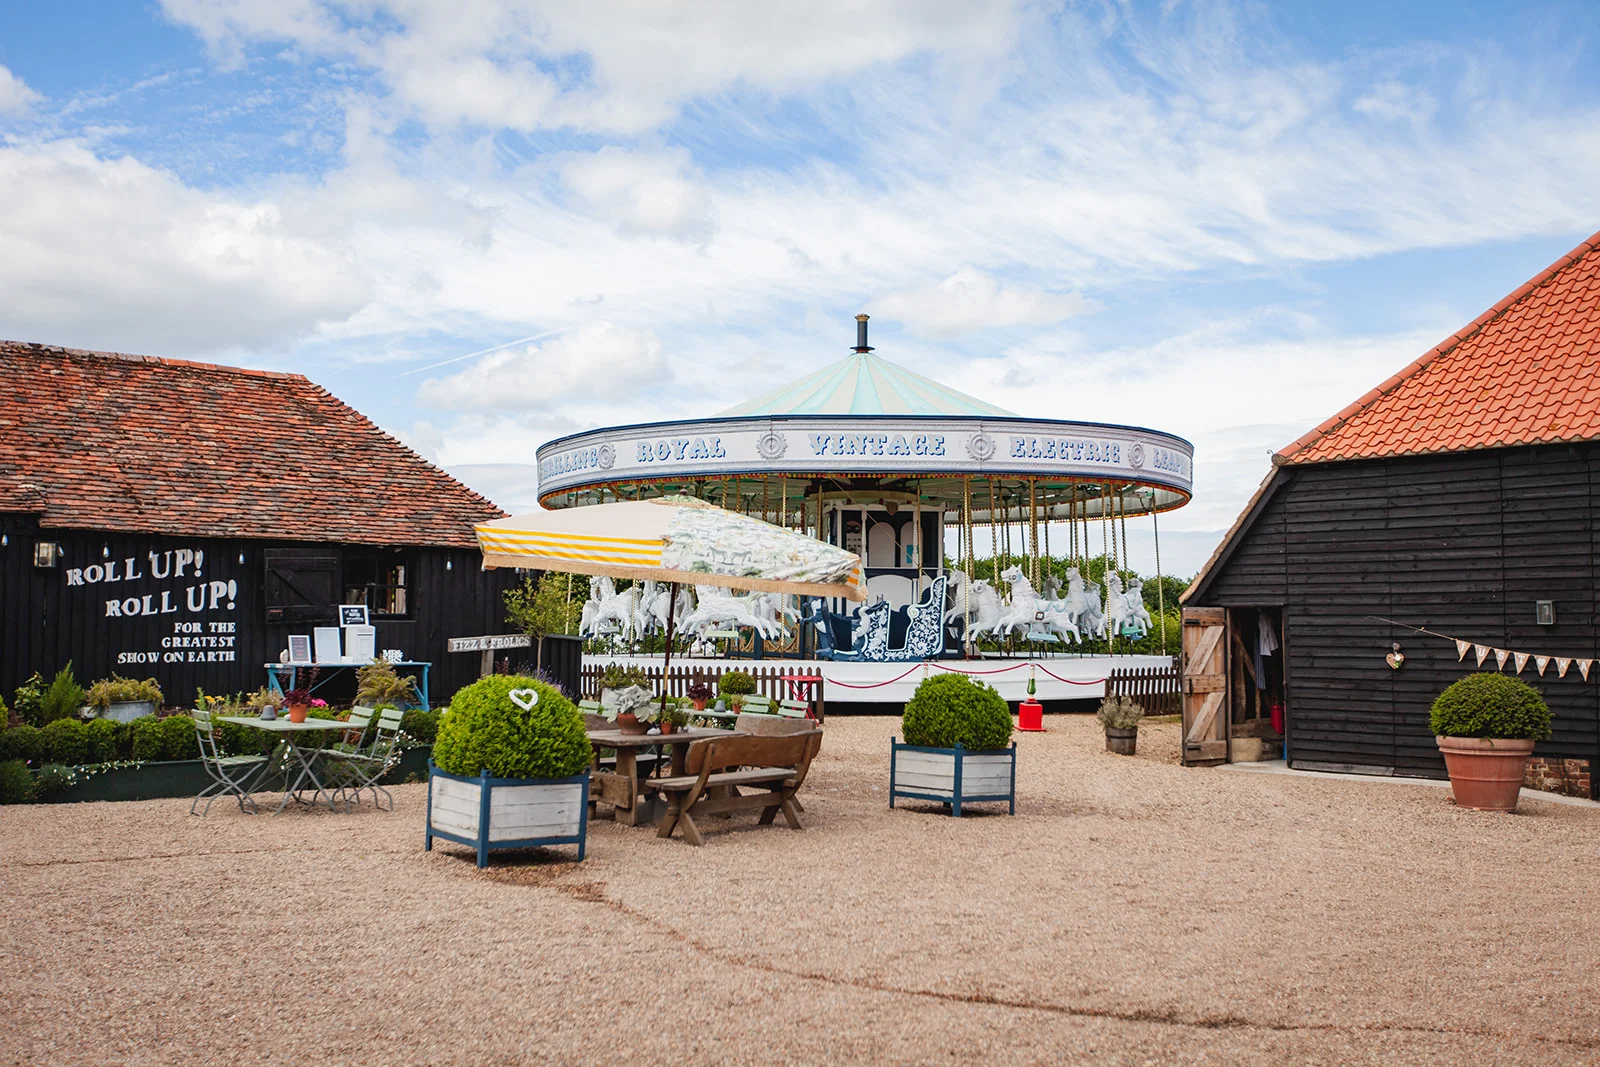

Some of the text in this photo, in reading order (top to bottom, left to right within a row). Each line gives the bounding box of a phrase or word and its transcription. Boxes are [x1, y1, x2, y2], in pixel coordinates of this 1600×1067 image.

[636, 437, 726, 463] ROYAL
[808, 433, 946, 457] VINTAGE
[1009, 436, 1121, 463] ELECTRIC
[66, 548, 203, 586] ROLL UP!
[105, 579, 237, 617] ROLL UP!
[174, 622, 236, 634] FOR THE
[161, 636, 236, 648] GREATEST
[453, 636, 530, 651] FIZZ & FROLICS
[117, 651, 235, 664] SHOW ON EARTH
[1458, 643, 1526, 665] JUST
